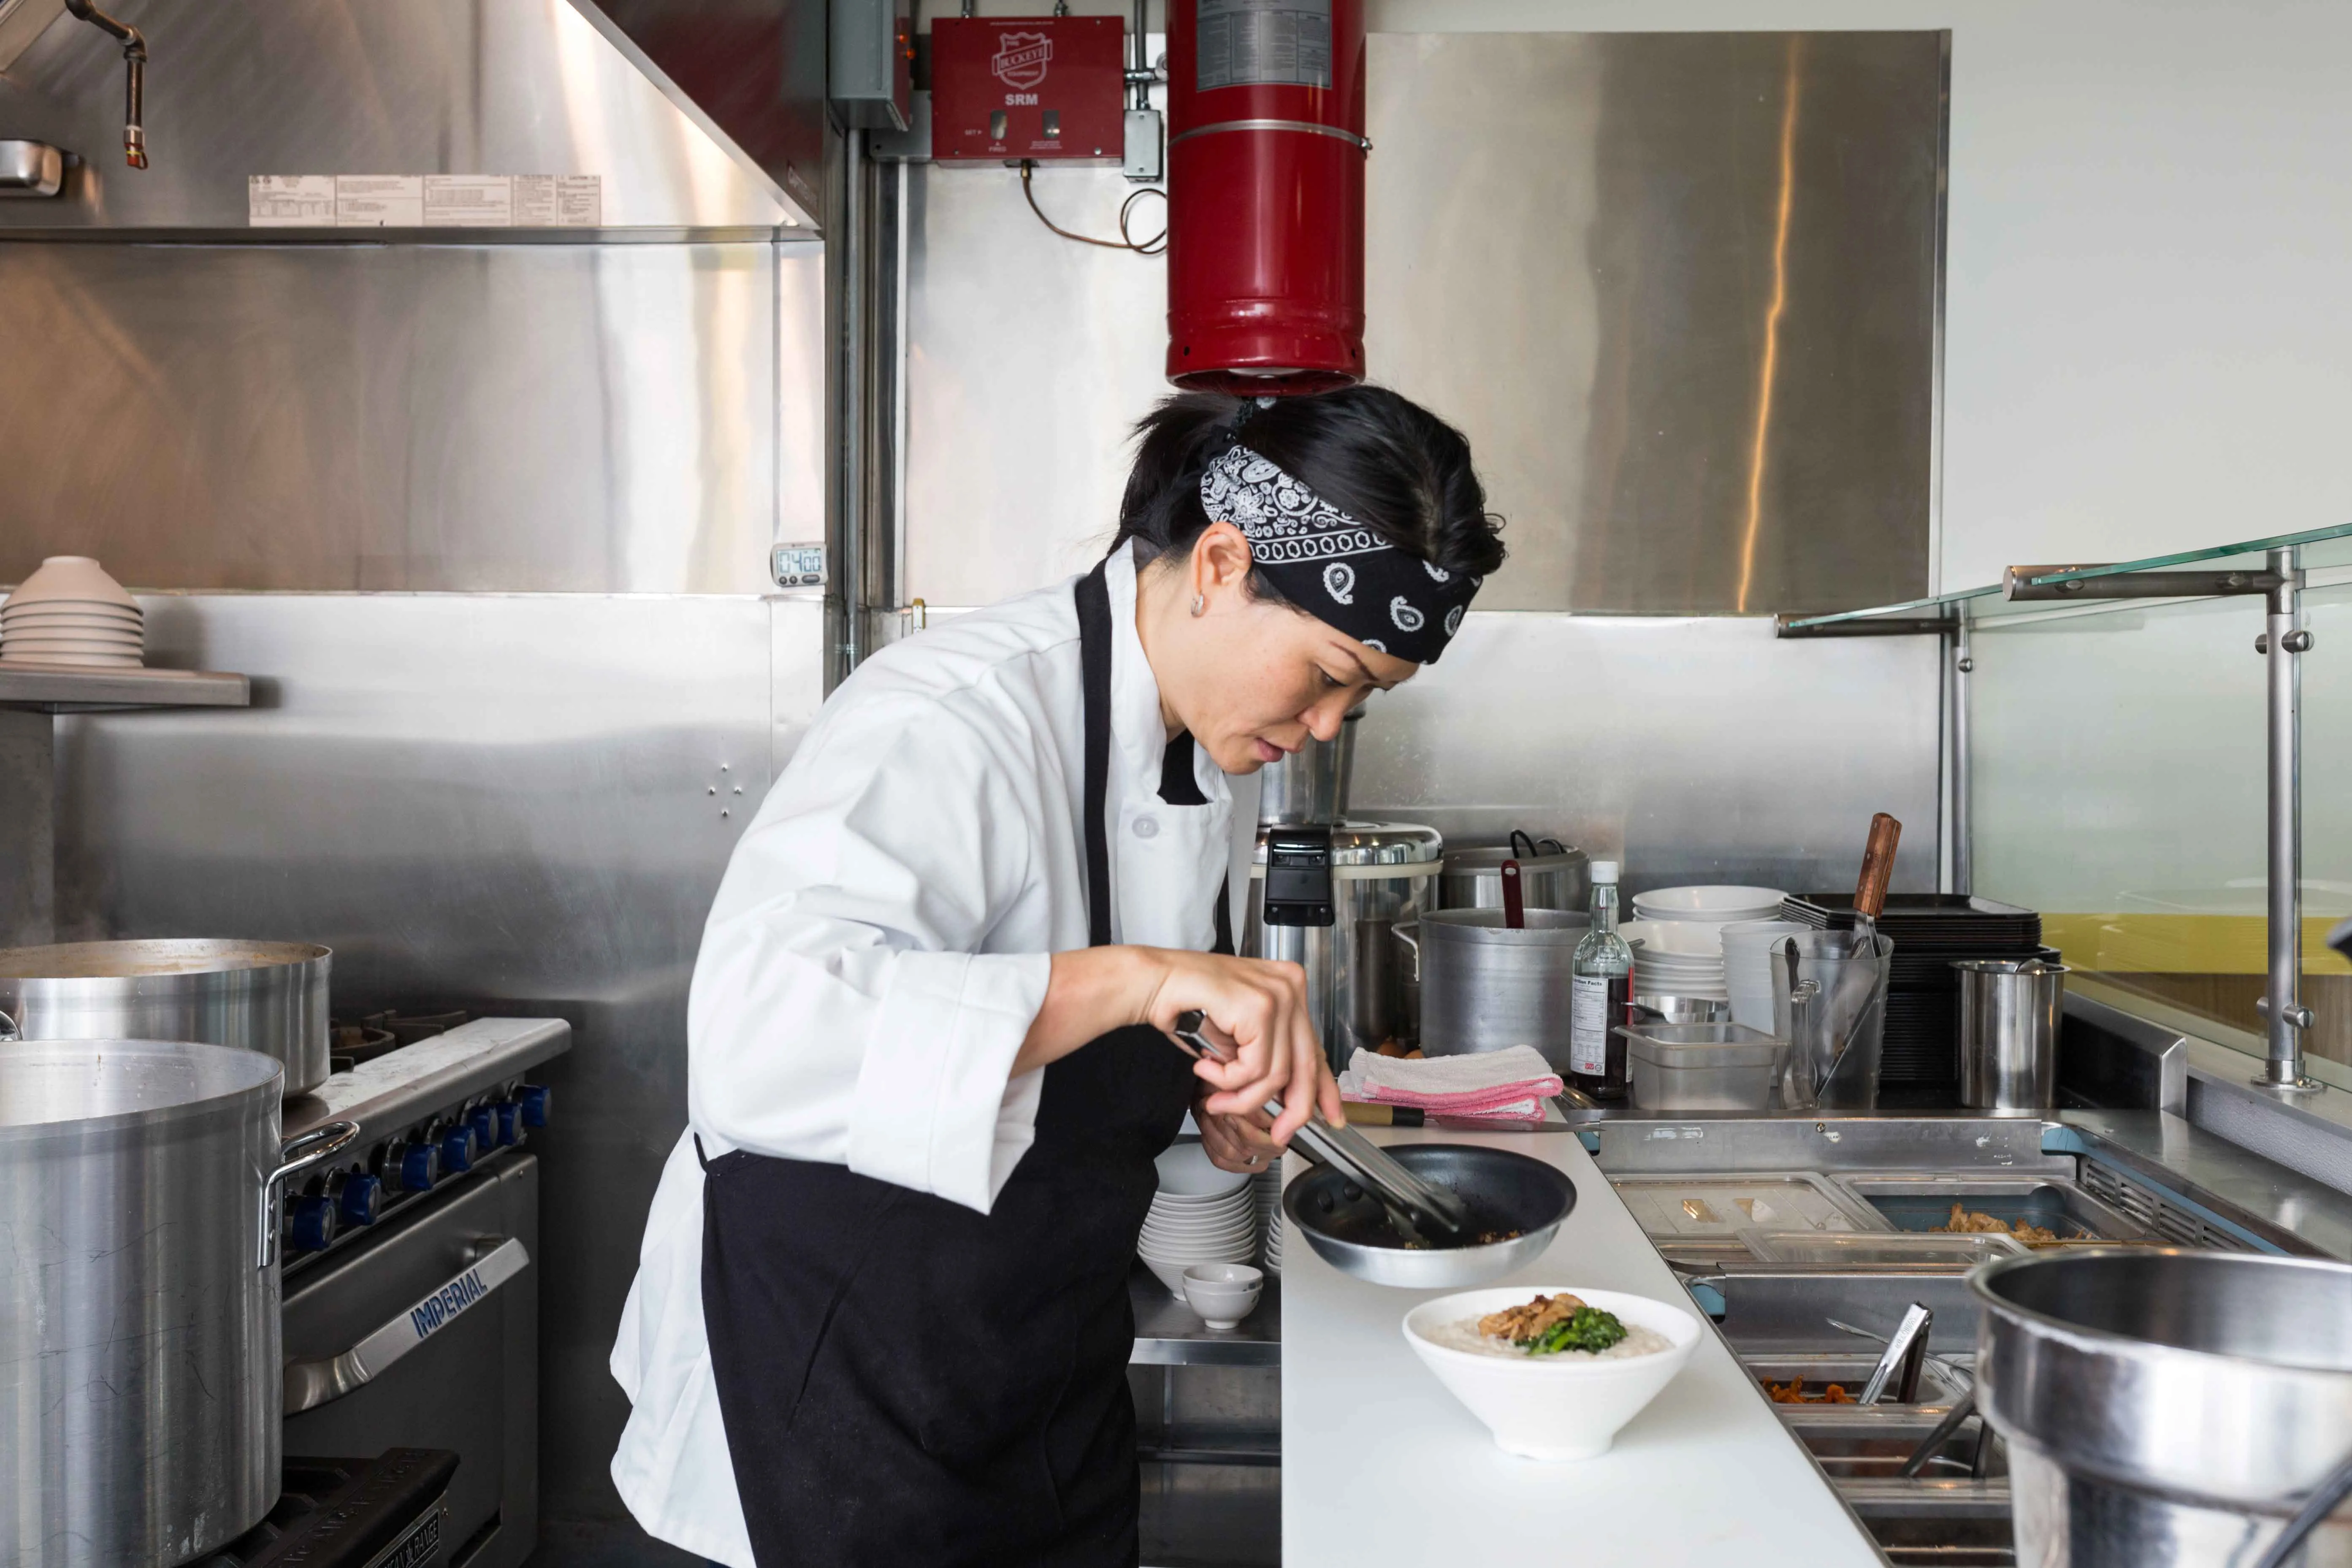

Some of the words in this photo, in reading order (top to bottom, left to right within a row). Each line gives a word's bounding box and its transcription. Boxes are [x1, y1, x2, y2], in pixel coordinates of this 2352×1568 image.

[1005, 94, 1038, 105] SRM
[410, 1268, 488, 1339] IMPERIAL
[415, 1519, 437, 1558] RANGE
